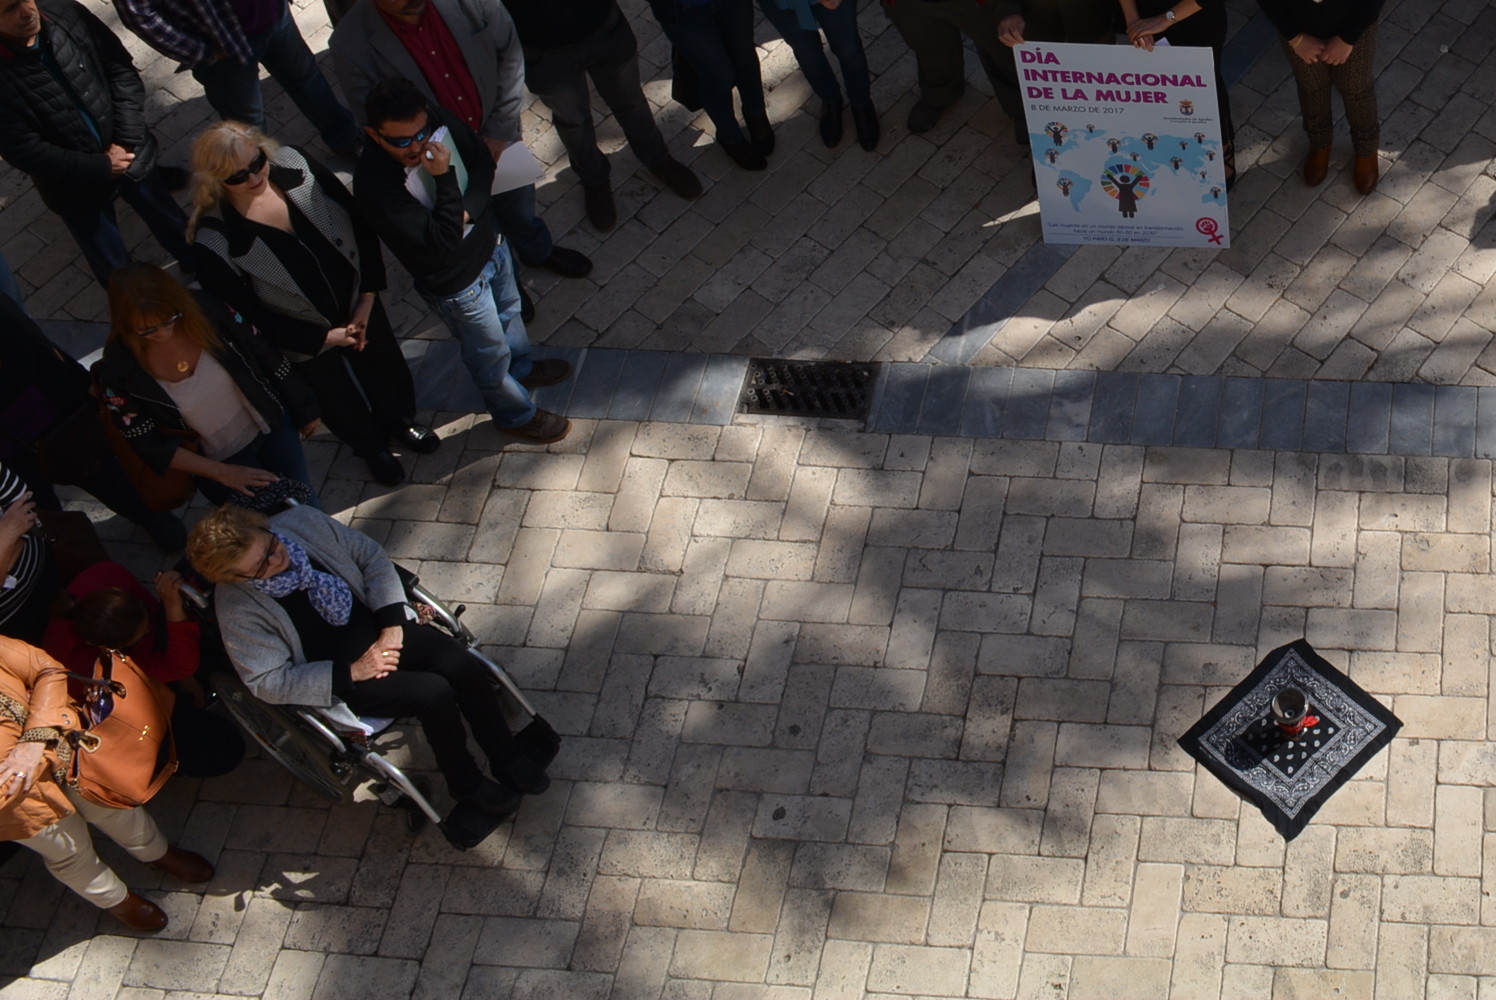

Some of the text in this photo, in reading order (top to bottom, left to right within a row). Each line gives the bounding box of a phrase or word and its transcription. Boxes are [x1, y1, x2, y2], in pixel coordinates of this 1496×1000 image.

[1020, 47, 1061, 65] DÍA
[1023, 68, 1207, 88] INTERNACIONAL
[1026, 86, 1169, 105] DE LA MUJER
[1038, 104, 1051, 112] DE
[1052, 105, 1087, 113] MARZO
[1088, 106, 1101, 114] DE
[1102, 107, 1125, 115] 2017
